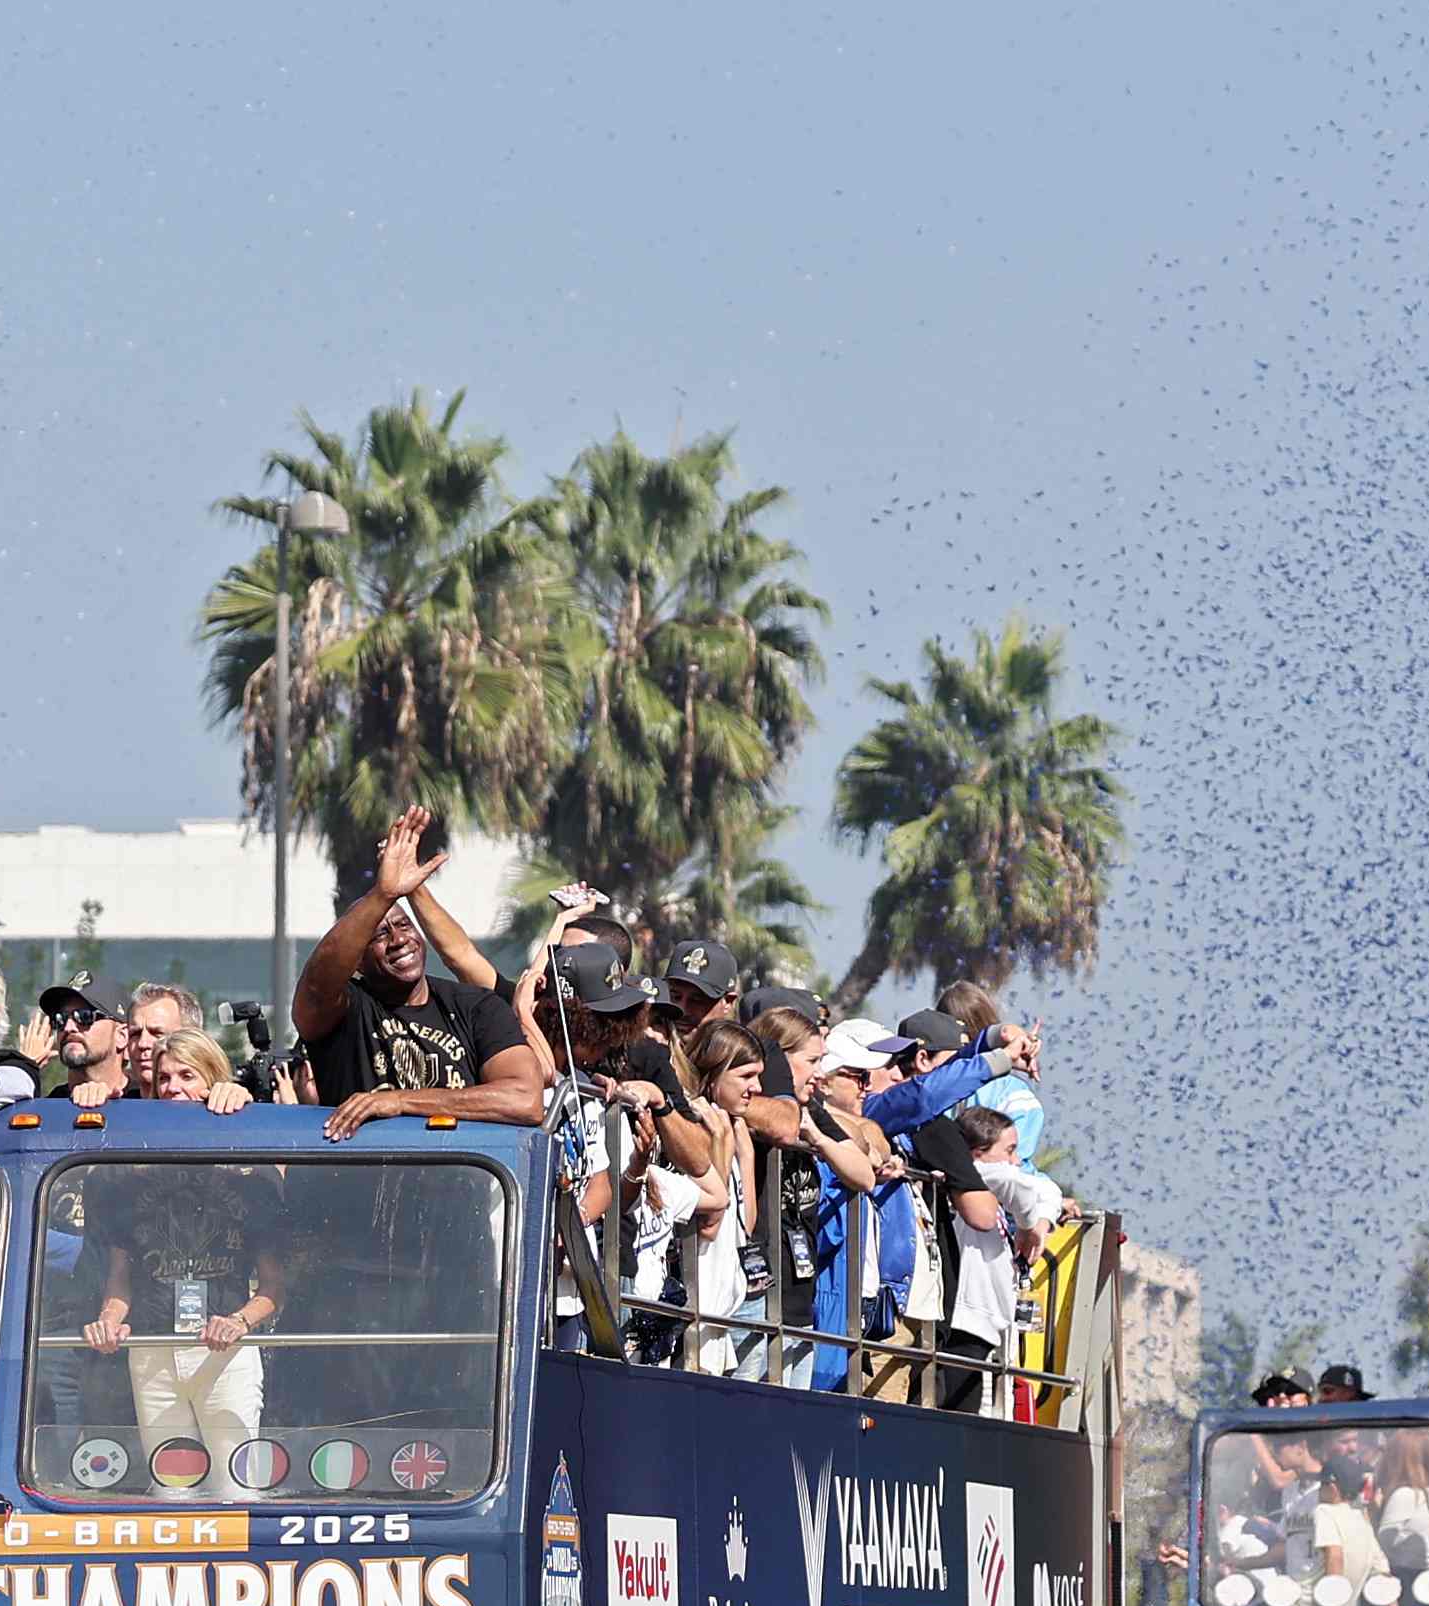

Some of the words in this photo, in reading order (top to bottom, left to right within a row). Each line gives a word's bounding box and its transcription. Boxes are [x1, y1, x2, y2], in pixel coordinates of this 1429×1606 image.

[409, 1021, 466, 1061] SERIES
[445, 1064, 465, 1089] LA
[279, 1514, 411, 1545] 2025
[552, 1547, 571, 1573] WORLD
[614, 1540, 670, 1601] Yakult
